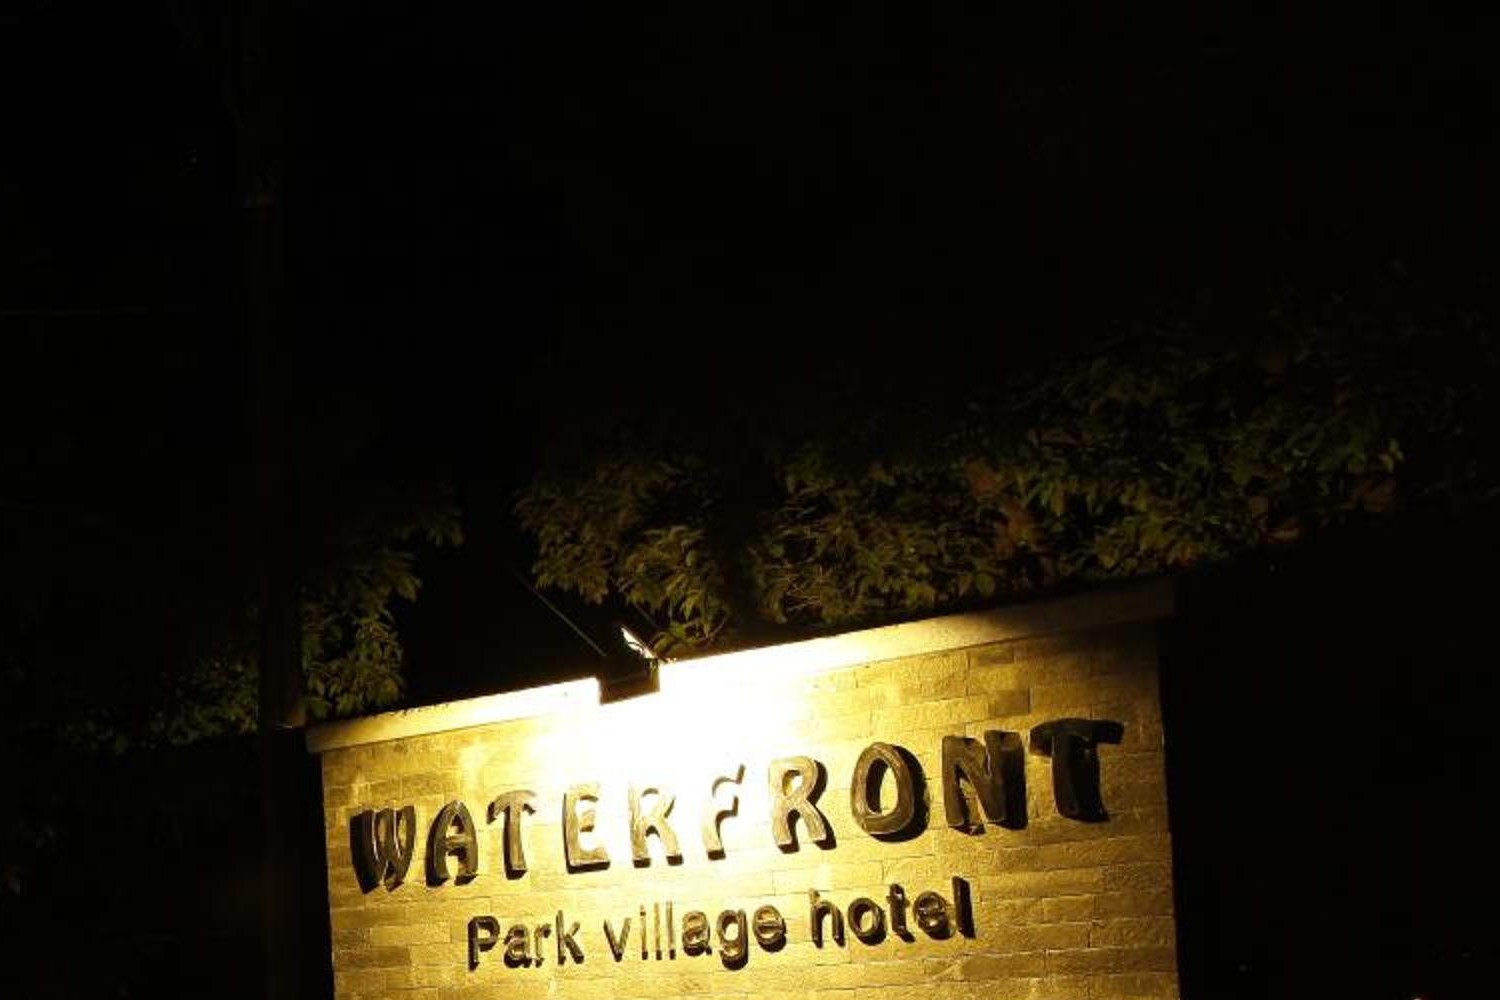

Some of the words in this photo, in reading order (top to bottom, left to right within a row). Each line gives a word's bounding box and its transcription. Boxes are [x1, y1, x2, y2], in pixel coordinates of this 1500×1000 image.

[350, 718, 1124, 893] WATERFRONT
[468, 910, 585, 972] Park
[604, 901, 787, 970] village
[811, 877, 976, 948] hotel
